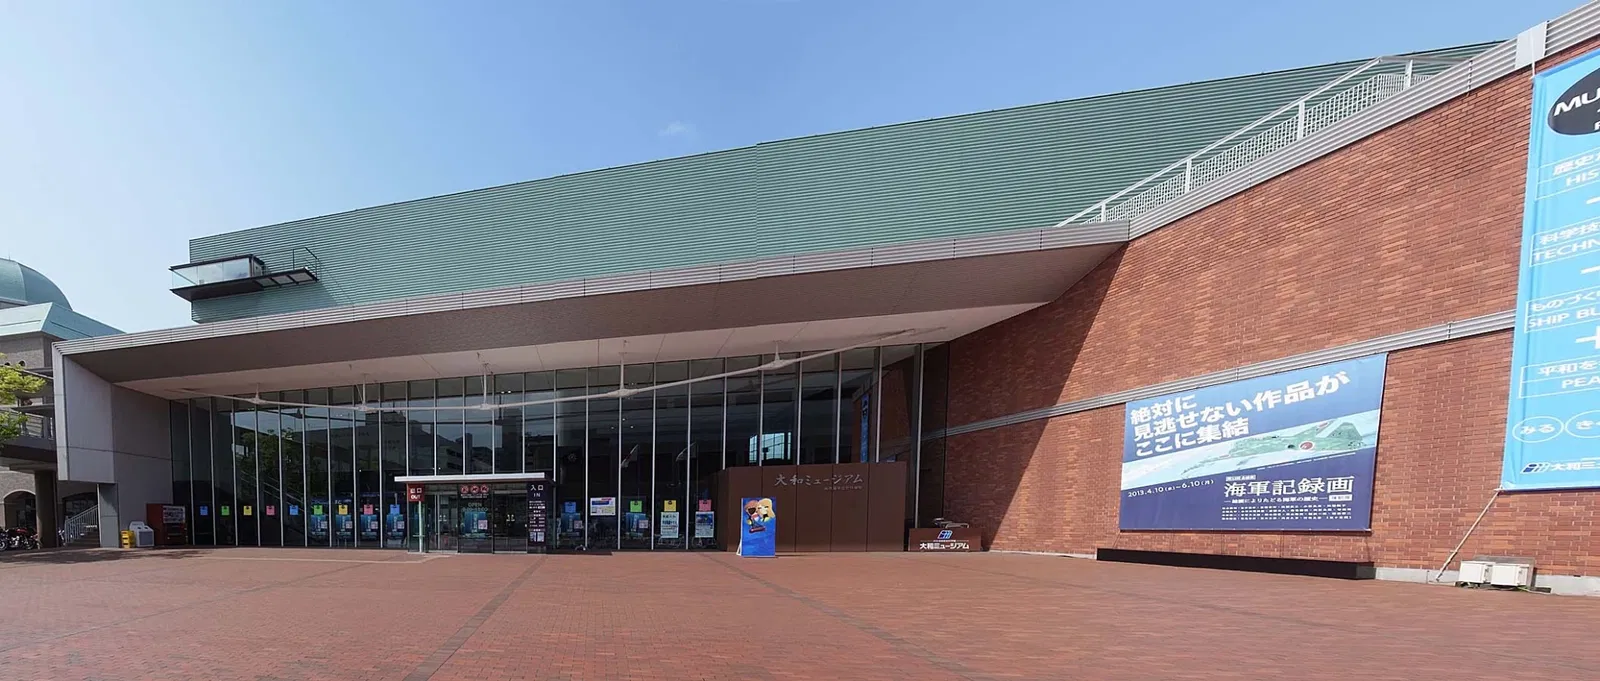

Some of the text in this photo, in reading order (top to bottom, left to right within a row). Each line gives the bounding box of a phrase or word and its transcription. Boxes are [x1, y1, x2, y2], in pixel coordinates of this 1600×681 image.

[1553, 152, 1600, 176] 歴史
[1528, 312, 1570, 328] SHIP
[1537, 359, 1600, 376] 平和を
[1131, 394, 1197, 425] 絶対に
[1134, 371, 1351, 441] 見逃せない作品が
[1136, 417, 1250, 457] ここに集結
[774, 473, 863, 486] 大和ミュージアム
[1223, 475, 1355, 498] 海軍記録画
